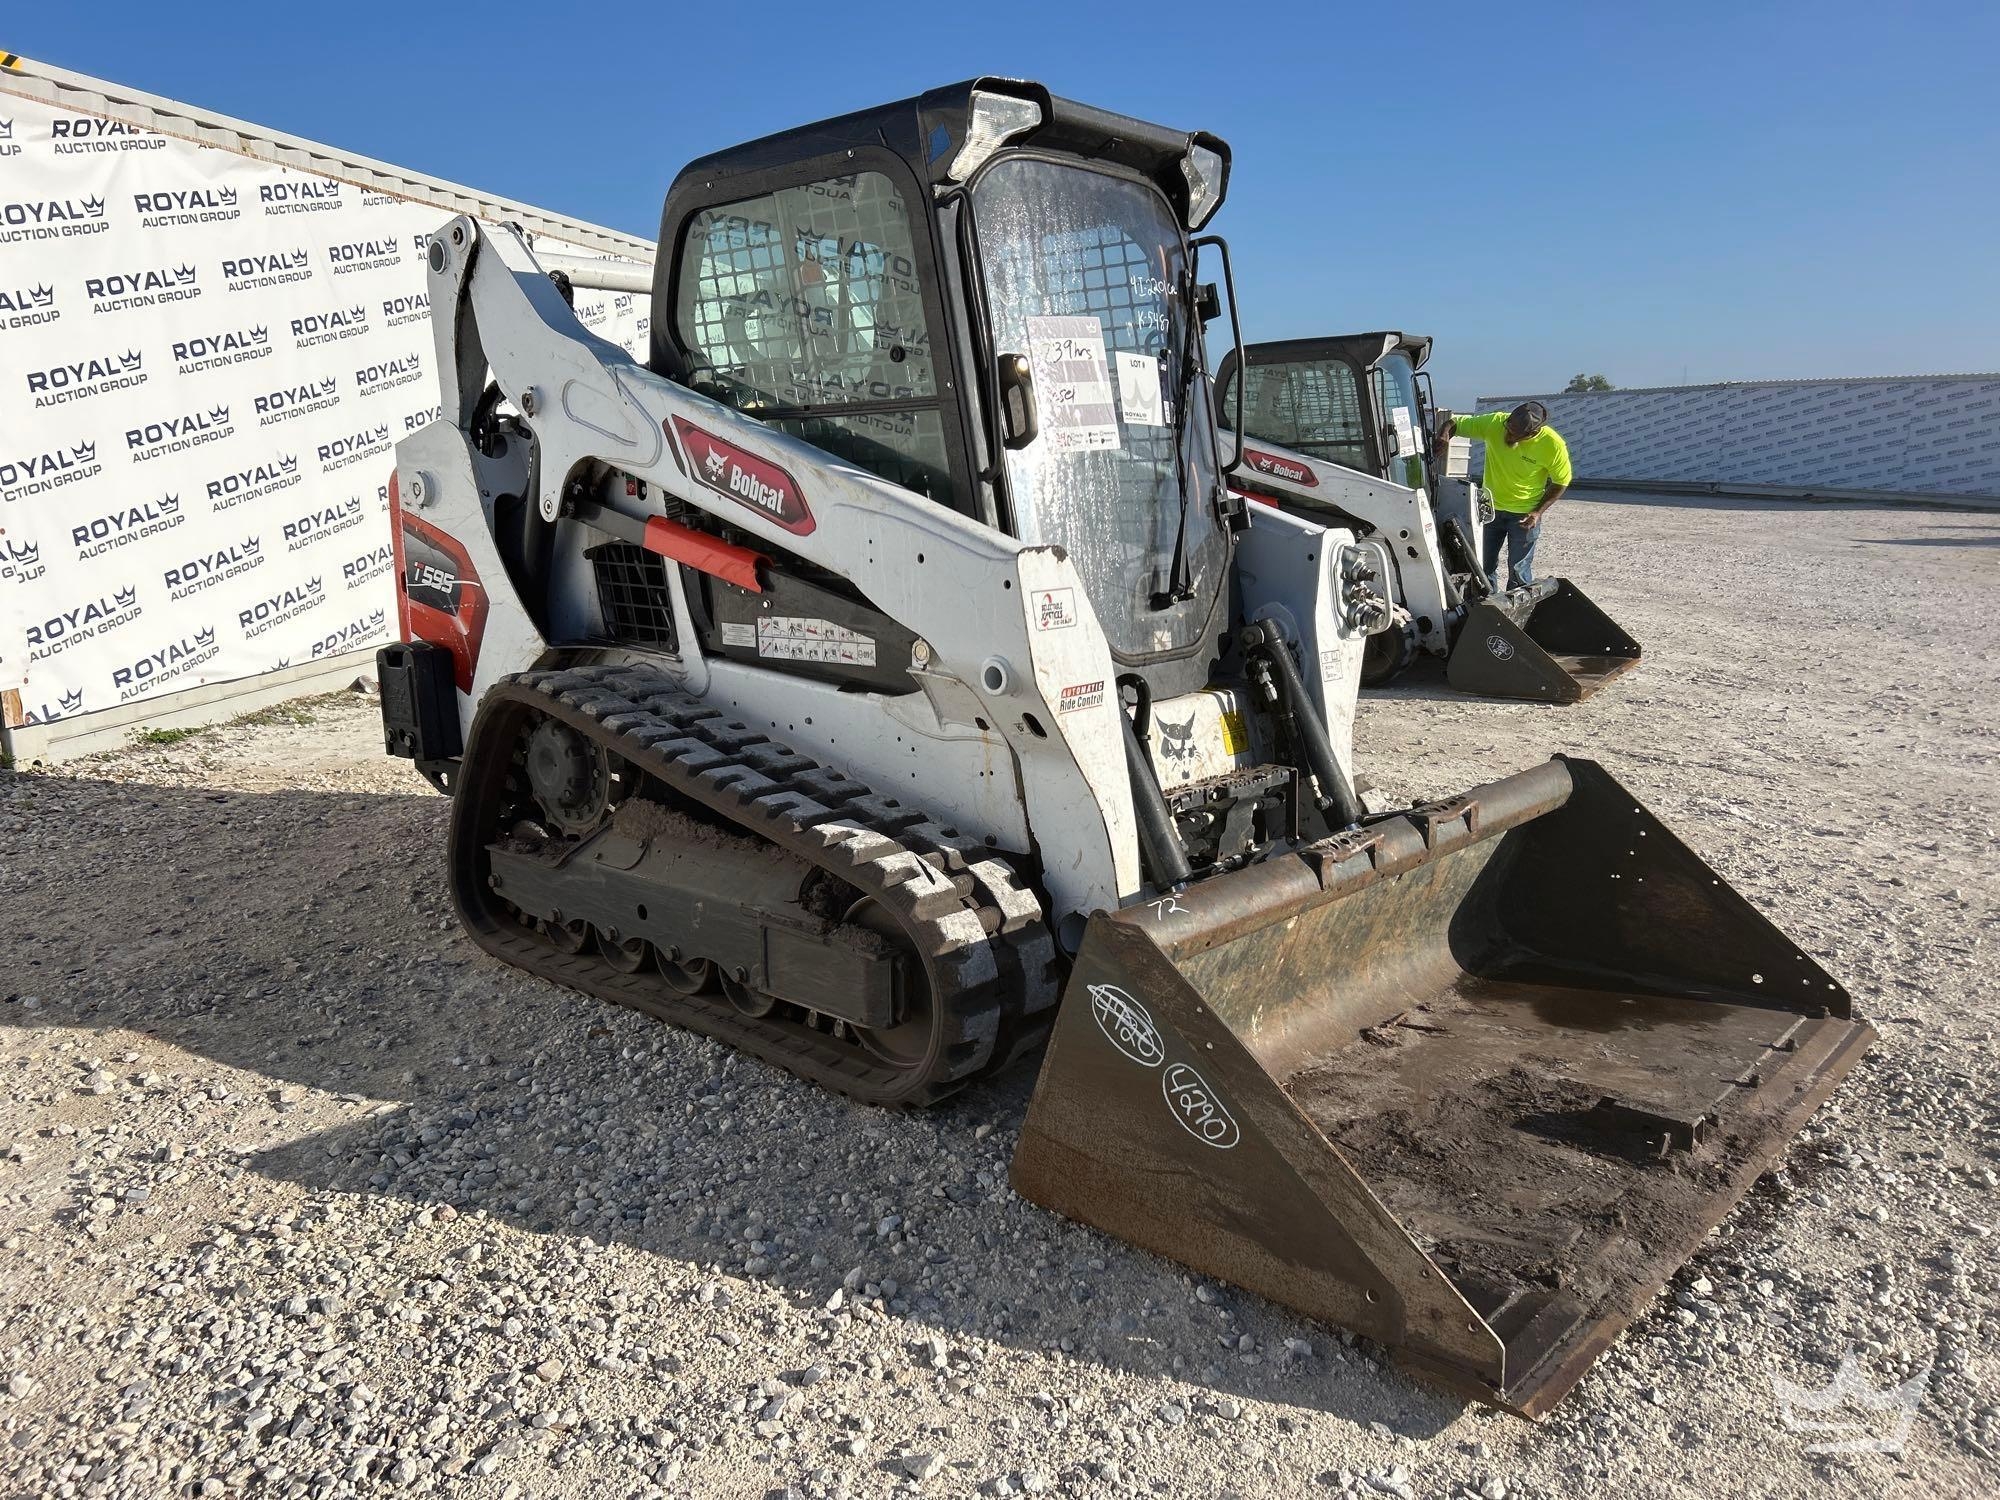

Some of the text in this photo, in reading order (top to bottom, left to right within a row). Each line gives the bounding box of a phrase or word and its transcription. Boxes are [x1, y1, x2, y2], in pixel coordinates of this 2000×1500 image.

[54, 140, 166, 154] AUCTION GROUP
[134, 190, 219, 213] ROYAL
[260, 182, 324, 202] ROYAL
[0, 201, 84, 225] OYAL
[142, 210, 240, 228] AUCTION GROUP
[265, 201, 342, 215] AUCTION GROUP
[62, 222, 109, 237] GROUP
[222, 253, 293, 278] ROYAL
[329, 241, 386, 262] ROYAL
[334, 257, 401, 275] AUCTION GROUP
[86, 270, 175, 298] ROYAL
[228, 270, 313, 292] AUCTION GROUP
[94, 288, 201, 314] AUCTION GROUP
[10, 310, 60, 328] GROUP
[291, 310, 353, 336] ROYAL
[387, 313, 420, 327] AUCTION
[587, 316, 606, 327] GROUP
[172, 331, 251, 361] ROYAL
[296, 325, 369, 348] AUCTION GROUP
[27, 358, 121, 392] ROYAL
[179, 347, 272, 375] AUCTION GROUP
[356, 359, 407, 386] ROYAL
[1130, 360, 1141, 368] LOT
[35, 374, 147, 408] AUCTION GROUP
[254, 383, 322, 414] ROYAL
[360, 372, 422, 397] AUCTION GROUP
[260, 397, 340, 427] AUCTION GROUP
[405, 406, 441, 430] ROYA
[125, 413, 211, 449] ROYAL
[133, 427, 234, 463] AUCTION GROUP
[317, 430, 375, 461] ROYAL
[0, 451, 74, 485] OYAL
[323, 442, 392, 474] AUCTION GROUP
[1273, 463, 1304, 480] Bobcat
[4, 464, 101, 502] CTION GROUP
[206, 463, 280, 500] ROYAL
[213, 475, 301, 512] AUCTION GROUP
[730, 464, 784, 514] Bobcat
[72, 504, 159, 546] ROYAL
[283, 504, 347, 540] ROYAL
[288, 514, 364, 552] AUCTION GROUP
[79, 515, 185, 561] AUCTION GROUP
[164, 546, 243, 588] ROYAL
[171, 556, 264, 602] AUCTION GROUP
[347, 567, 384, 590] AUCTION
[414, 562, 455, 593] T595
[27, 598, 116, 647] ROYAL
[239, 587, 307, 628] ROYAL
[245, 595, 325, 640] AUCTION GROUP
[30, 607, 142, 663] AUCTION GROUP
[312, 618, 371, 658] ROYAL
[356, 625, 386, 645] GROUP
[113, 640, 196, 688] ROYAL
[121, 646, 219, 701] AUCTION GROUP
[1060, 691, 1104, 711] Ride Control
[1062, 681, 1104, 697] AUTOMATIC
[1170, 1068, 1227, 1140] 4290
